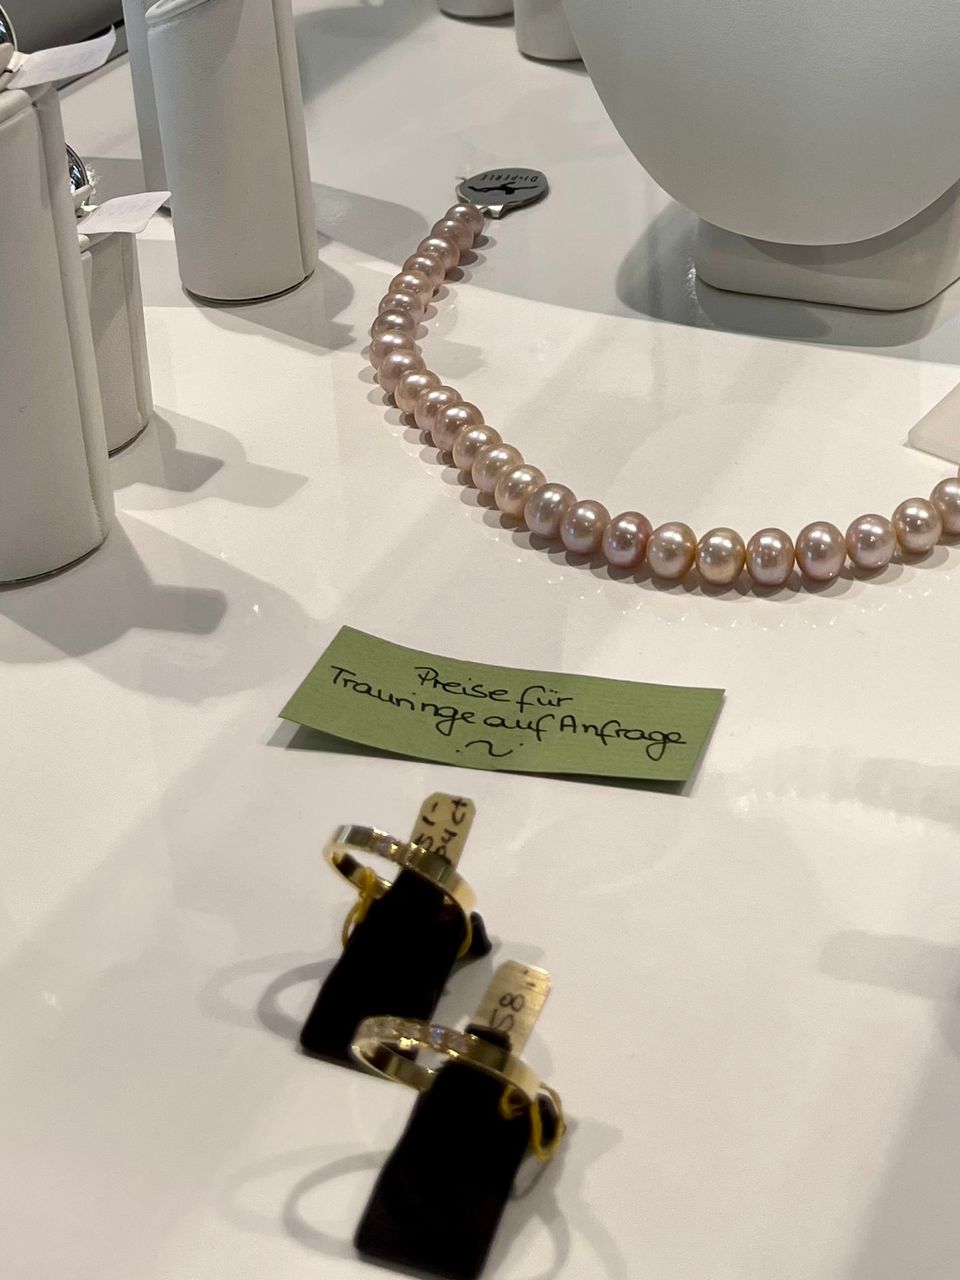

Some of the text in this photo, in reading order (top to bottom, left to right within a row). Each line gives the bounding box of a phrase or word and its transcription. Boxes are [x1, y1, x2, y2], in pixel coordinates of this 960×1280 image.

[414, 666, 574, 713] Preise für
[484, 713, 555, 742] auf
[560, 715, 687, 761] Anfrage
